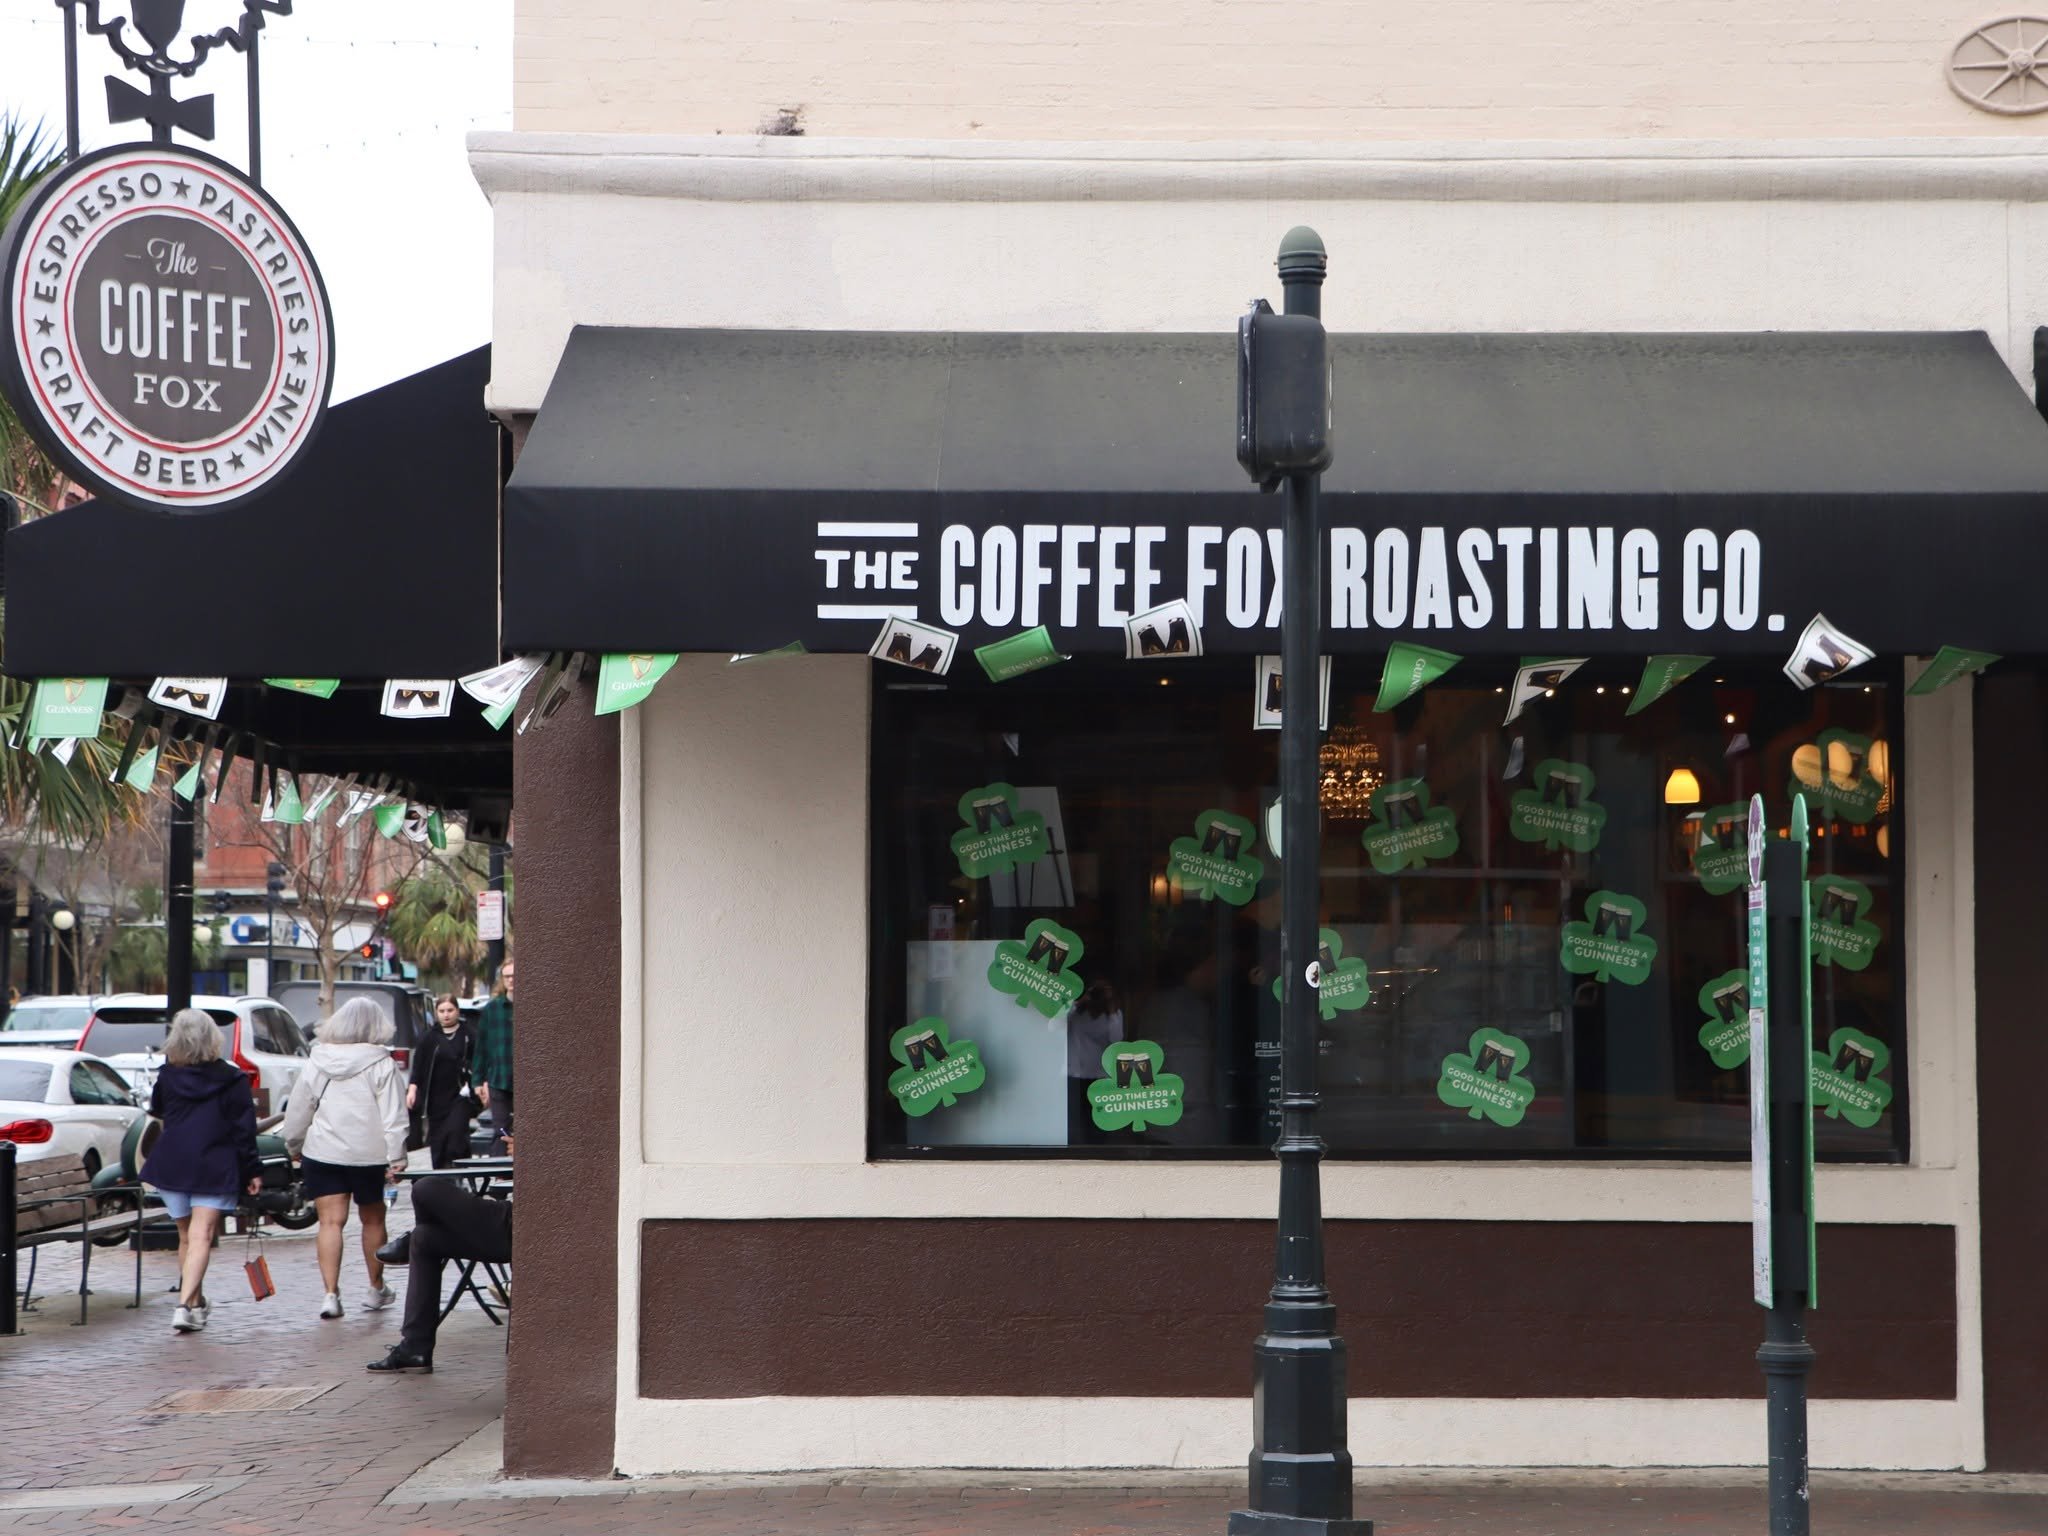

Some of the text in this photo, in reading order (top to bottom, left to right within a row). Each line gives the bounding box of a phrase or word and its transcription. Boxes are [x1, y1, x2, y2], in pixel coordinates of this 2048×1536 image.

[34, 172, 162, 304] ESPRESSO
[147, 237, 199, 276] The
[199, 183, 309, 337] PASTRIES
[99, 279, 252, 370] COFFEE
[133, 372, 222, 413] FOX
[40, 346, 221, 485] CRAFT BEER
[245, 372, 307, 456] WINE
[814, 550, 919, 590] THE
[940, 524, 1167, 628] COFFEE
[1330, 526, 1659, 631] ROASTING
[1682, 527, 1786, 632] CO.
[1517, 804, 1544, 815] GOOD
[1545, 809, 1568, 820] TIME
[1571, 814, 1589, 824] FOR
[1523, 814, 1587, 835] GUINNESS
[960, 840, 986, 853] GOOD
[988, 833, 1010, 844] TIME
[1011, 827, 1030, 838] FOR
[1371, 835, 1398, 848] GOOD
[1399, 828, 1421, 840] TIME
[1423, 822, 1441, 833] FOR
[1382, 831, 1444, 856] GUINNESS
[970, 836, 1033, 861] GUINNESS
[1175, 851, 1202, 864] GOOD
[1205, 859, 1227, 872] TIME
[1228, 866, 1246, 878] FOR
[1181, 862, 1243, 888] GUINNESS
[1701, 857, 1728, 869] GOOD
[1567, 936, 1595, 947] GOOD
[1596, 942, 1619, 953] TIME
[1621, 947, 1640, 957] FOR
[1821, 924, 1842, 937] TIME
[1844, 932, 1864, 942] FOR
[1864, 937, 1872, 945] A
[1574, 946, 1638, 967] GUINNESS
[1000, 953, 1072, 997] GOOD TIME FOR A
[1003, 965, 1060, 1001] GUINNESS
[1334, 974, 1353, 984] FOR
[1354, 971, 1361, 979] A
[1708, 1030, 1734, 1047] GOOD
[1721, 1031, 1751, 1051] GUIN
[898, 1053, 974, 1094] GOOD TIME FOR A
[910, 1065, 970, 1099] GUINNESS
[1447, 1067, 1524, 1103] GOOD TIME FOR A
[1811, 1067, 1881, 1105] OOD TIME FOR A
[1095, 1089, 1177, 1103] GOOD TIME FOR A
[1104, 1099, 1168, 1113] GUINNESS
[1452, 1079, 1513, 1109] GUINNESS
